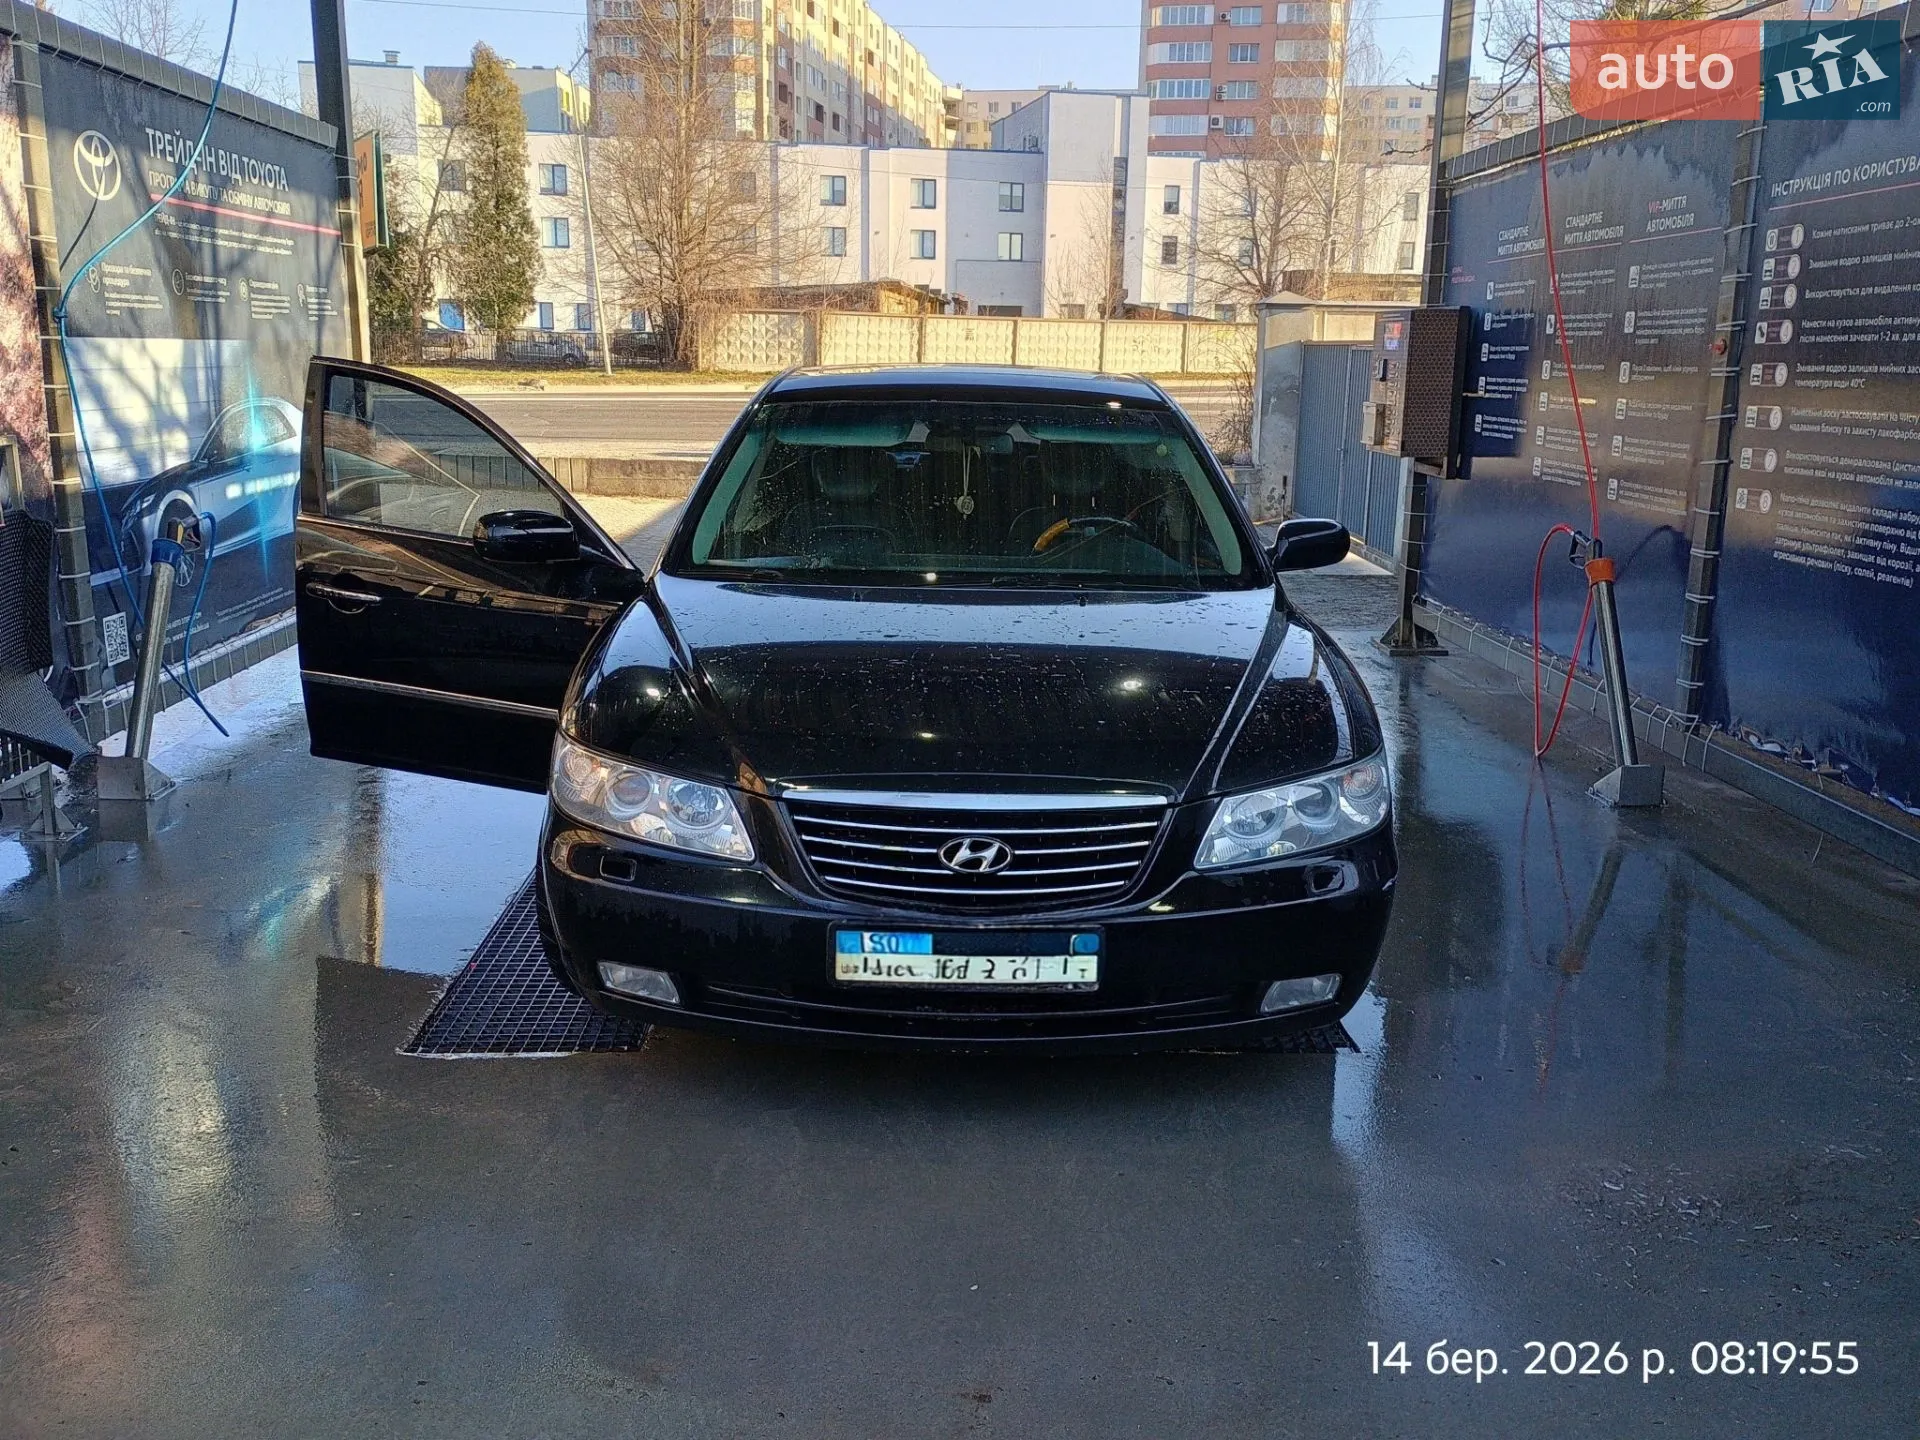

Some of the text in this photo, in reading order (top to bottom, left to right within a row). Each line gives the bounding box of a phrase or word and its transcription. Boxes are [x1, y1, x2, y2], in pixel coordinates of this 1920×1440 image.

[218, 148, 242, 186] ВІД
[242, 156, 289, 192] TOYOTA
[1771, 171, 1832, 197] ІНСТРУКЦІЯ
[1833, 168, 1851, 186] ПО
[1646, 212, 1694, 233] АВТОМОБІЛЯ
[1833, 224, 1870, 236] натискання
[1871, 220, 1894, 233] триває
[1894, 219, 1904, 229] до
[1840, 256, 1860, 266] водою
[1862, 251, 1893, 264] залишків
[1805, 288, 1860, 299] Використовується
[1861, 287, 1873, 296] для
[1874, 284, 1911, 294] видалення
[1802, 319, 1827, 329] Нанести
[1827, 319, 1836, 328] на
[1836, 318, 1854, 329] кузов
[1854, 314, 1893, 326] автомобіля
[1799, 331, 1917, 343] після нанесення зачекати 1-2 хв. для
[1796, 363, 1826, 373] Змивання
[1826, 365, 1847, 374] водою
[1847, 363, 1878, 373] залишків
[1879, 363, 1906, 373] мийних
[1795, 379, 1832, 389] температура
[1889, 413, 1899, 422] на
[1899, 413, 1920, 425] чисту
[1821, 423, 1841, 435] блиску
[1843, 425, 1850, 434] та
[1851, 427, 1878, 438] захисту
[1785, 450, 1839, 464] Використовується
[1828, 470, 1836, 478] на
[1856, 474, 1893, 486] автомобіля
[1894, 479, 1902, 487] не
[1871, 507, 1898, 519] складні
[1837, 518, 1870, 530] захистити
[1870, 523, 1905, 537] поверхню
[1906, 528, 1917, 540] від
[1855, 536, 1881, 550] активну
[1847, 550, 1875, 563] захищає
[1876, 555, 1887, 567] від
[1806, 557, 1833, 570] речовин
[1854, 567, 1876, 580] солей,
[1877, 572, 1914, 588] реагентів)
